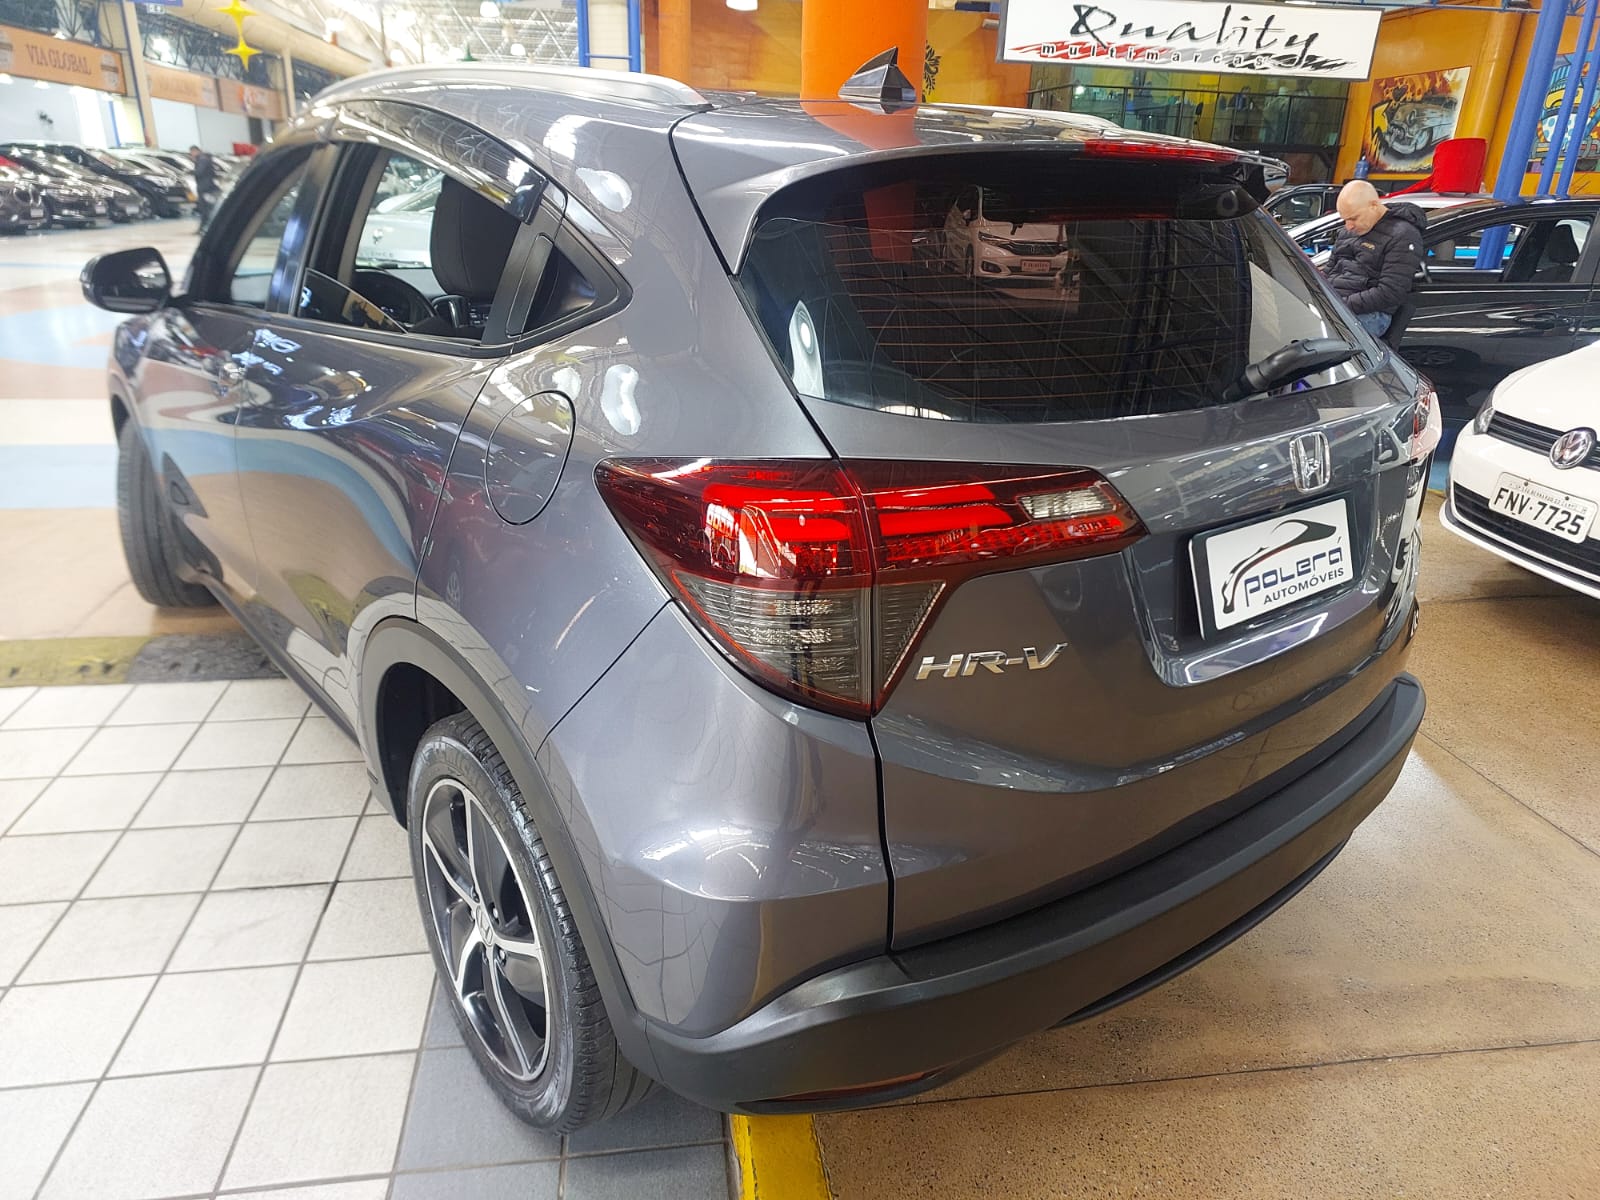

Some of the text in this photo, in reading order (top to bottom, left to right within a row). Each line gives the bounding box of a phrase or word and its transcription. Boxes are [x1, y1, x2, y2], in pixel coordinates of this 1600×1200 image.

[1070, 4, 1320, 60] Quality
[26, 43, 92, 75] VIA GLOBAL
[1041, 43, 1264, 66] multimarcas
[1263, 567, 1345, 605] AUTOMÓVEIS
[915, 642, 1068, 680] HR-V
